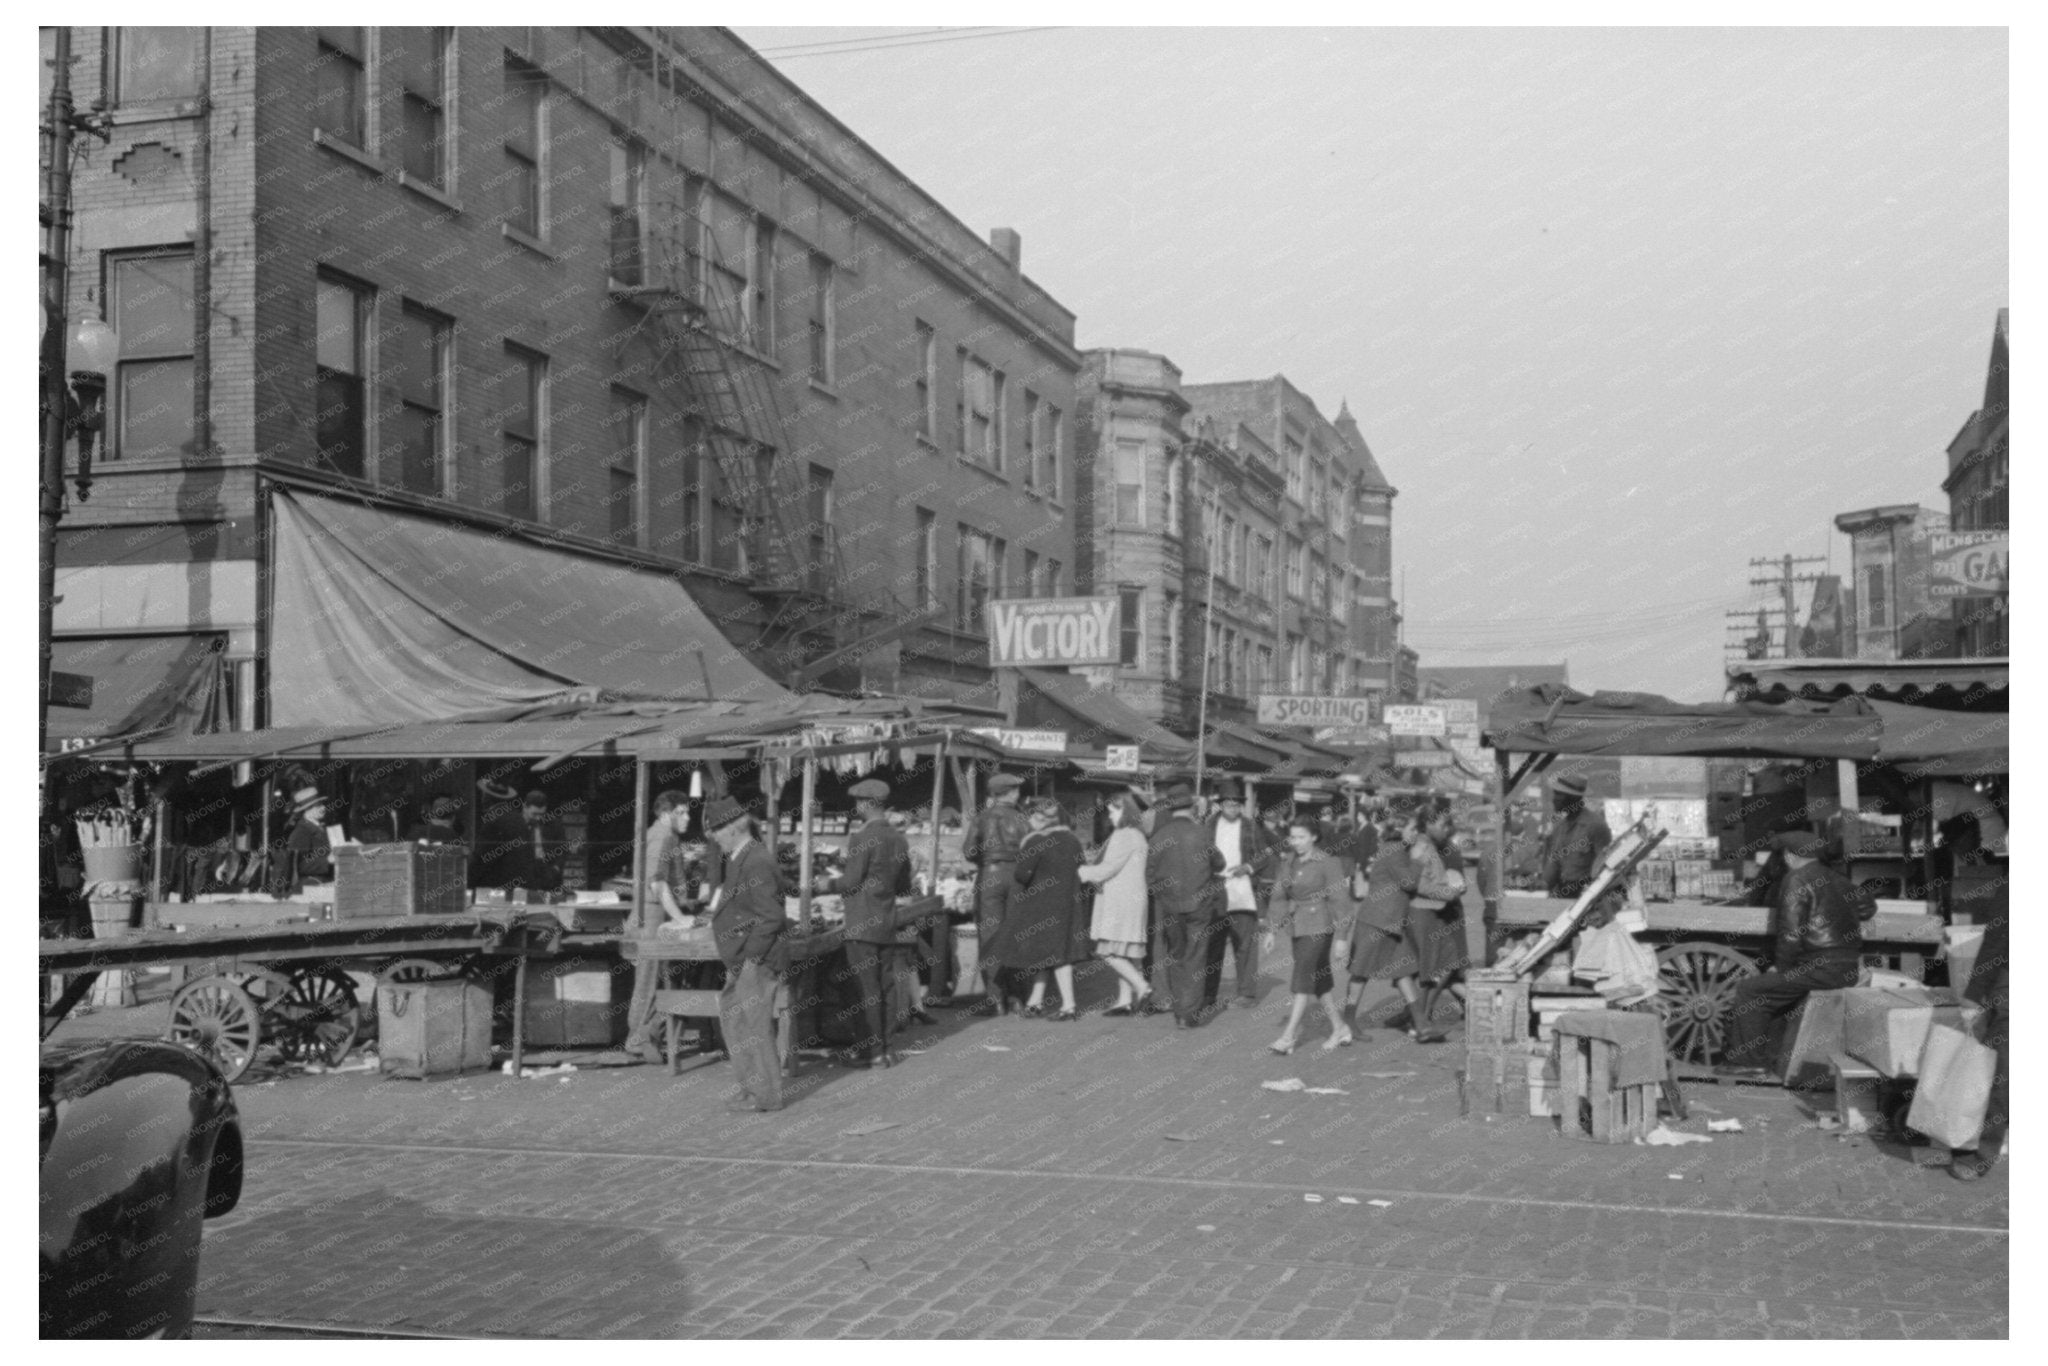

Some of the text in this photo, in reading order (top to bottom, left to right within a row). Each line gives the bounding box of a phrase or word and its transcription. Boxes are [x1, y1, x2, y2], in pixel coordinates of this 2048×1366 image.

[1964, 551, 2009, 582] GA
[994, 601, 1116, 661] VICTORY
[1275, 698, 1364, 723] SPORTING
